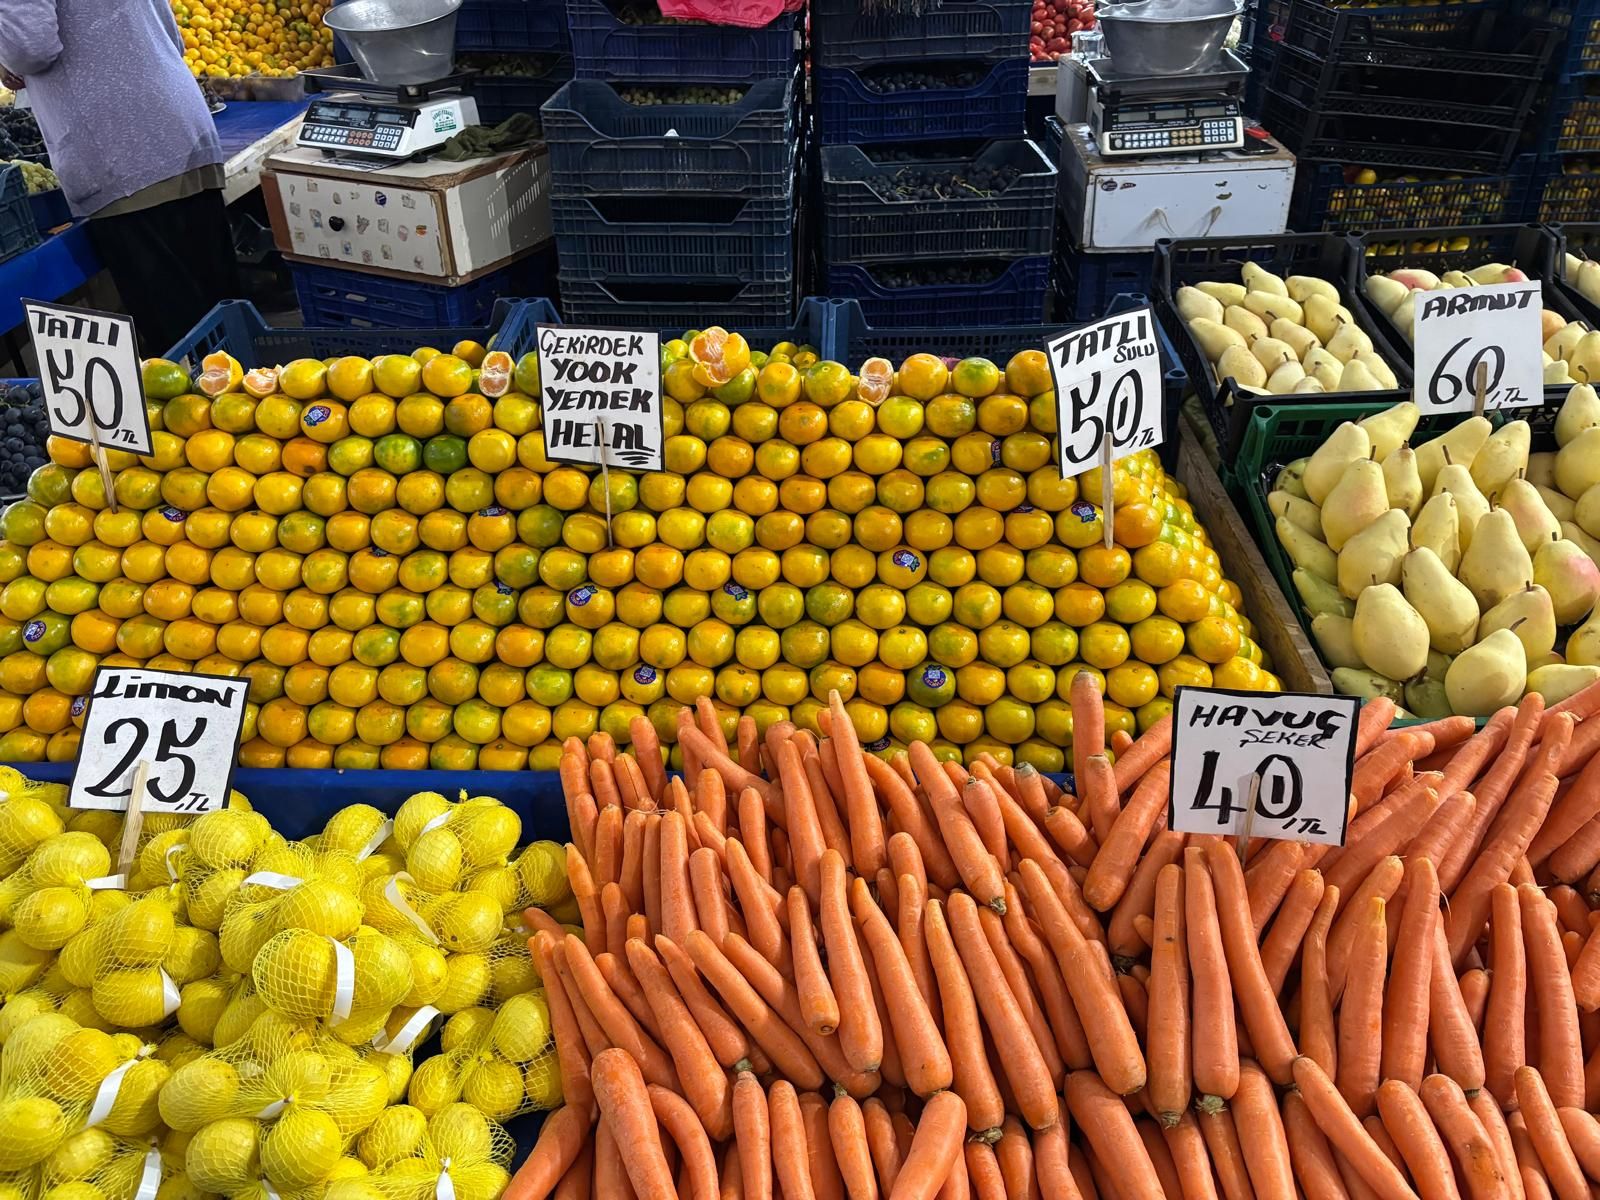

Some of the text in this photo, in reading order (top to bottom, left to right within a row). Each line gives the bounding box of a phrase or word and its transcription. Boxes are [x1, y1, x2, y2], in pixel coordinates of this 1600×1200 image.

[1421, 290, 1540, 321] ARMUT
[29, 310, 120, 347] TATLI
[1052, 315, 1147, 368] TATLI
[1113, 343, 1155, 363] SULU
[550, 358, 638, 384] YOOK
[544, 386, 654, 413] YEMEK
[550, 418, 656, 453] HELAL
